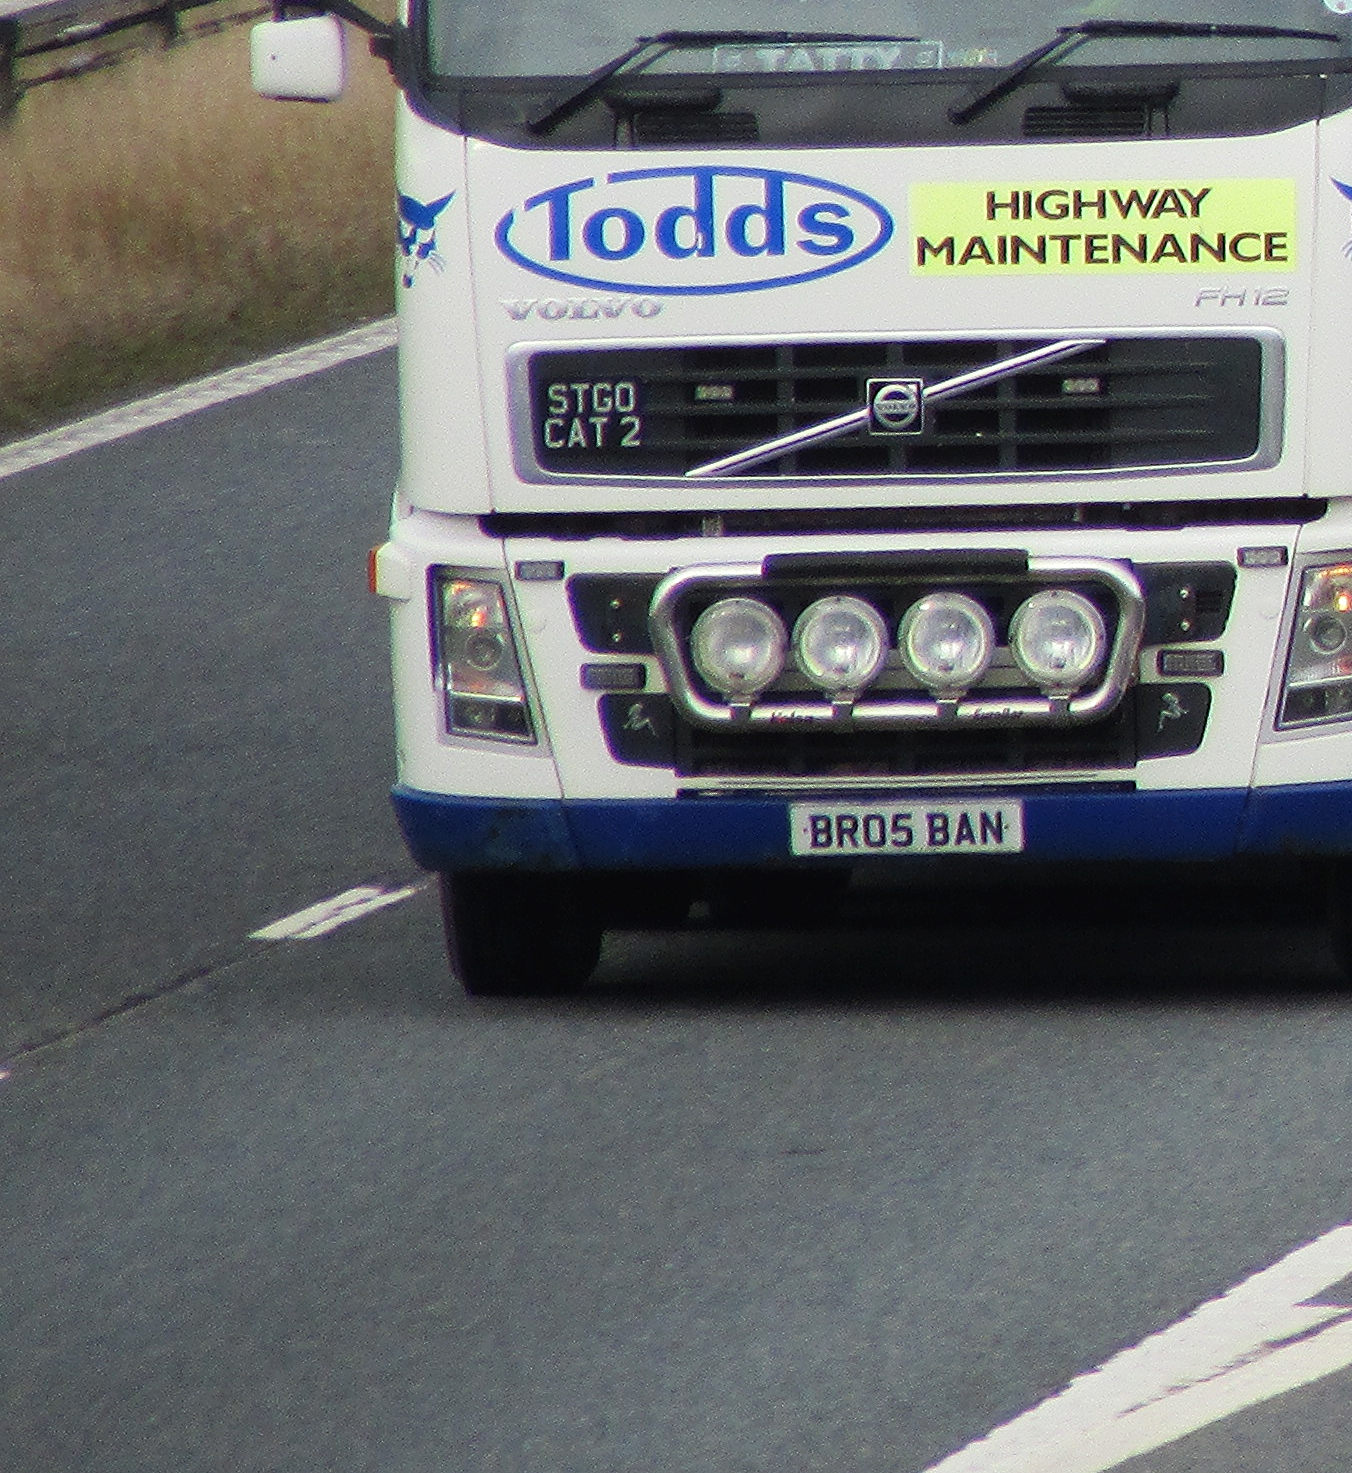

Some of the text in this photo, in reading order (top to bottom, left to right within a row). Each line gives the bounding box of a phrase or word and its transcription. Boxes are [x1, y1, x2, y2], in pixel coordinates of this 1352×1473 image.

[524, 167, 856, 262] Todds
[985, 187, 1212, 221] HIGHWAY
[916, 232, 1289, 267] MAINTENANCE
[500, 298, 665, 322] VOLVO
[548, 381, 636, 415] STGO
[544, 416, 642, 448] CAT 2
[925, 810, 1004, 847] BAN
